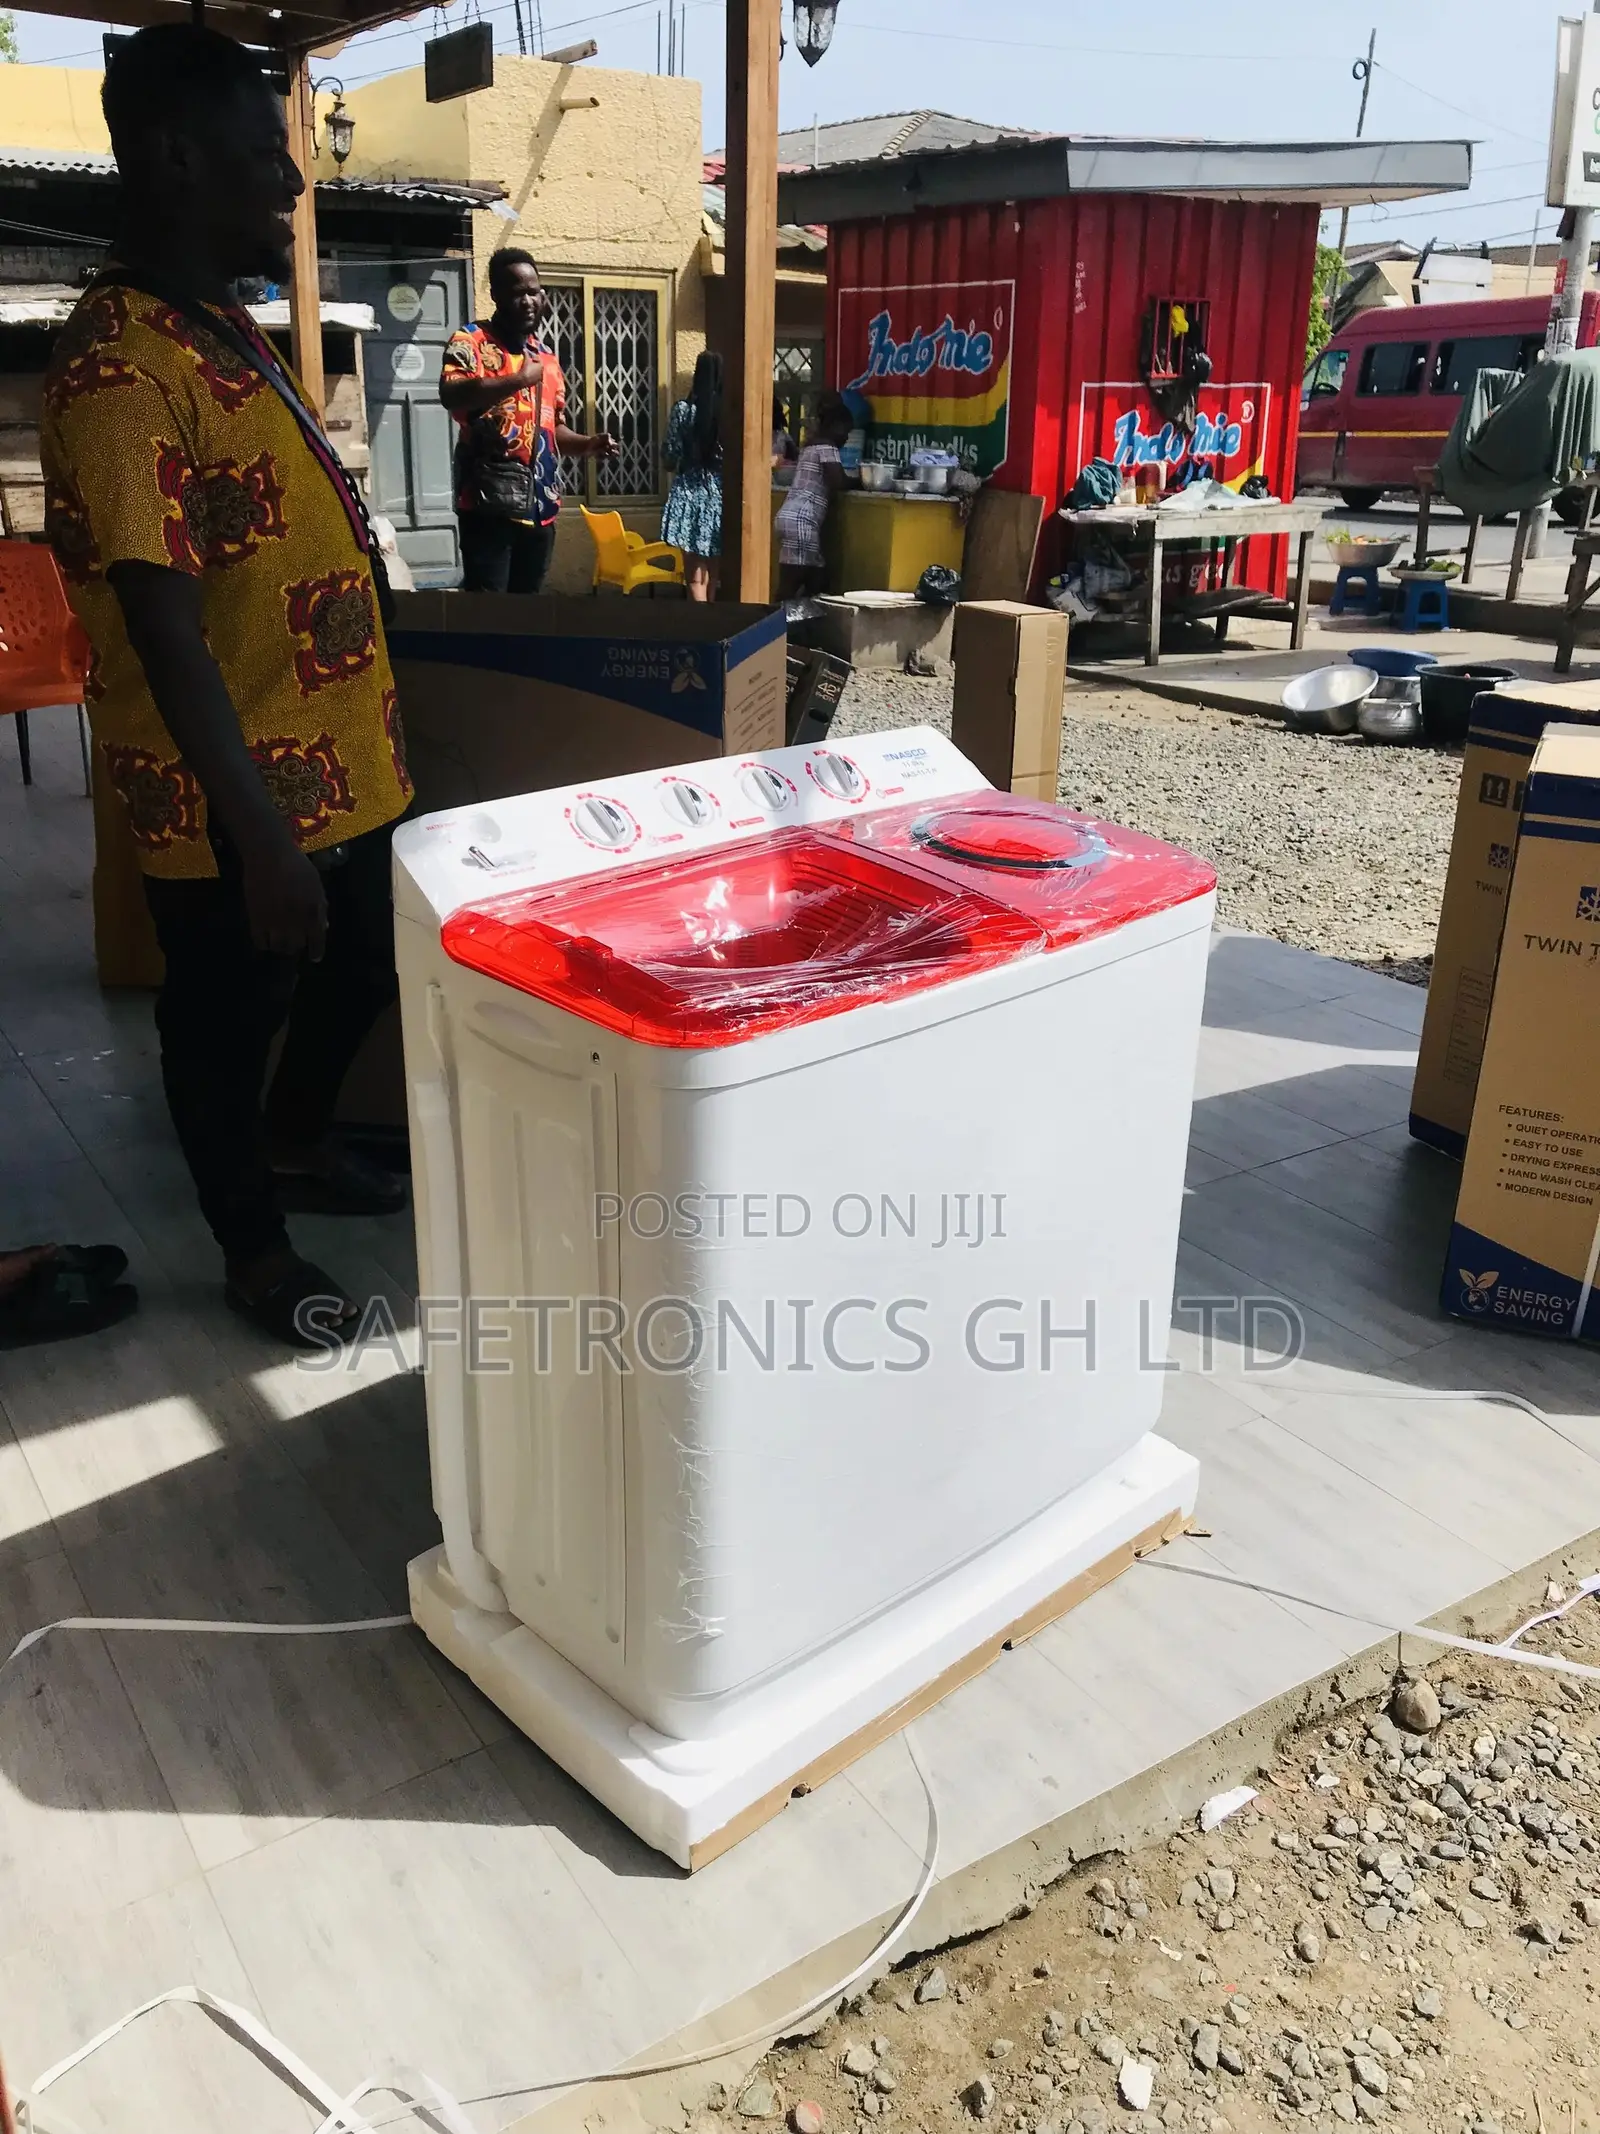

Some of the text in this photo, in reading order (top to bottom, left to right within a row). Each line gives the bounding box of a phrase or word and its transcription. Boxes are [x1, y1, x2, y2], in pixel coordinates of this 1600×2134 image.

[607, 647, 670, 662] SAVING
[600, 663, 670, 679] ENERGY
[889, 748, 927, 761] NASCO
[1524, 934, 1583, 957] TWIN
[1498, 1104, 1565, 1123] FEATURES:
[1515, 1123, 1549, 1136] QUIET
[1513, 1138, 1584, 1158] EASY TO USE
[1510, 1153, 1551, 1168] DRYING
[1507, 1167, 1538, 1180] HAND
[1540, 1172, 1572, 1187] WASH
[1504, 1182, 1594, 1207] MODERN DESIGN
[1496, 1286, 1576, 1310] ENERGY
[1493, 1302, 1565, 1325] SAVING
